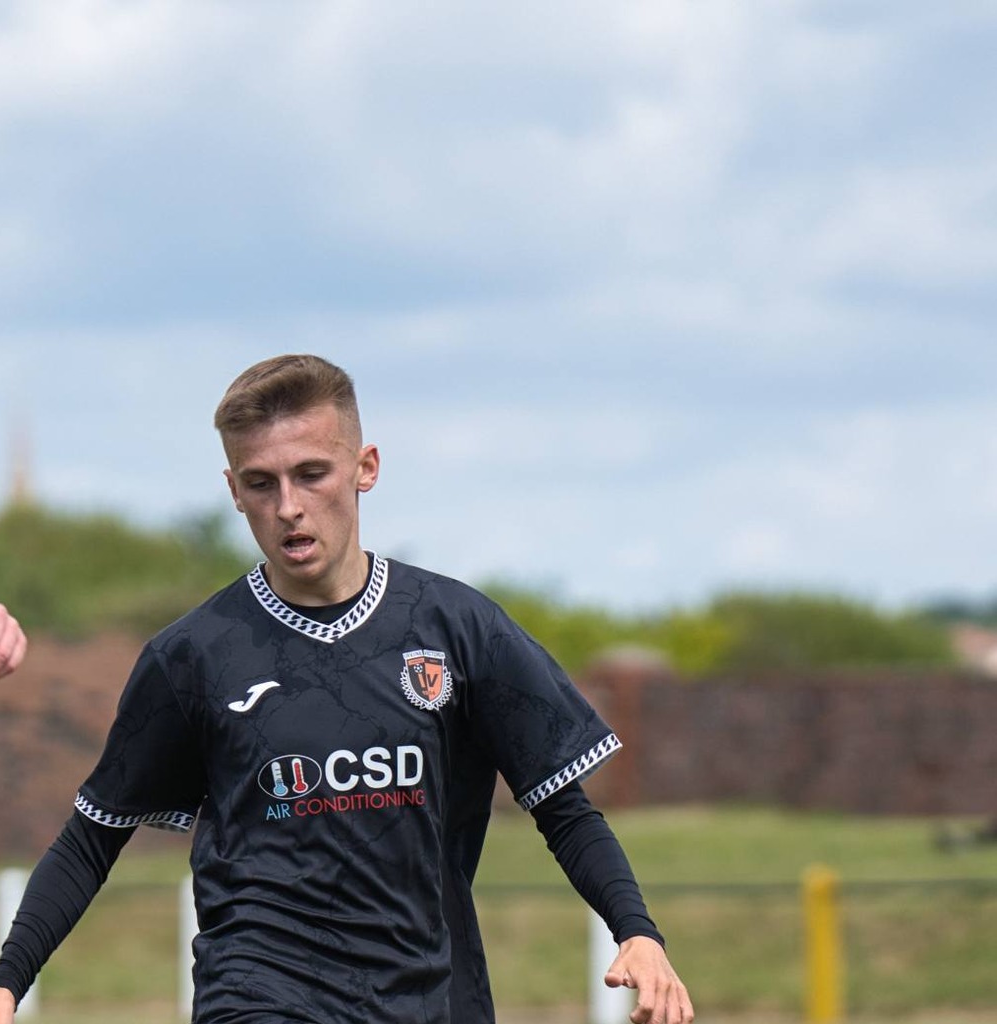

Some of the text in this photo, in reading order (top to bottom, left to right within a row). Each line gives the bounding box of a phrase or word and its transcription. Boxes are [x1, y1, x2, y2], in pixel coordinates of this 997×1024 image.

[325, 745, 424, 791] CSD
[265, 789, 426, 821] AIR CONDITIONING
